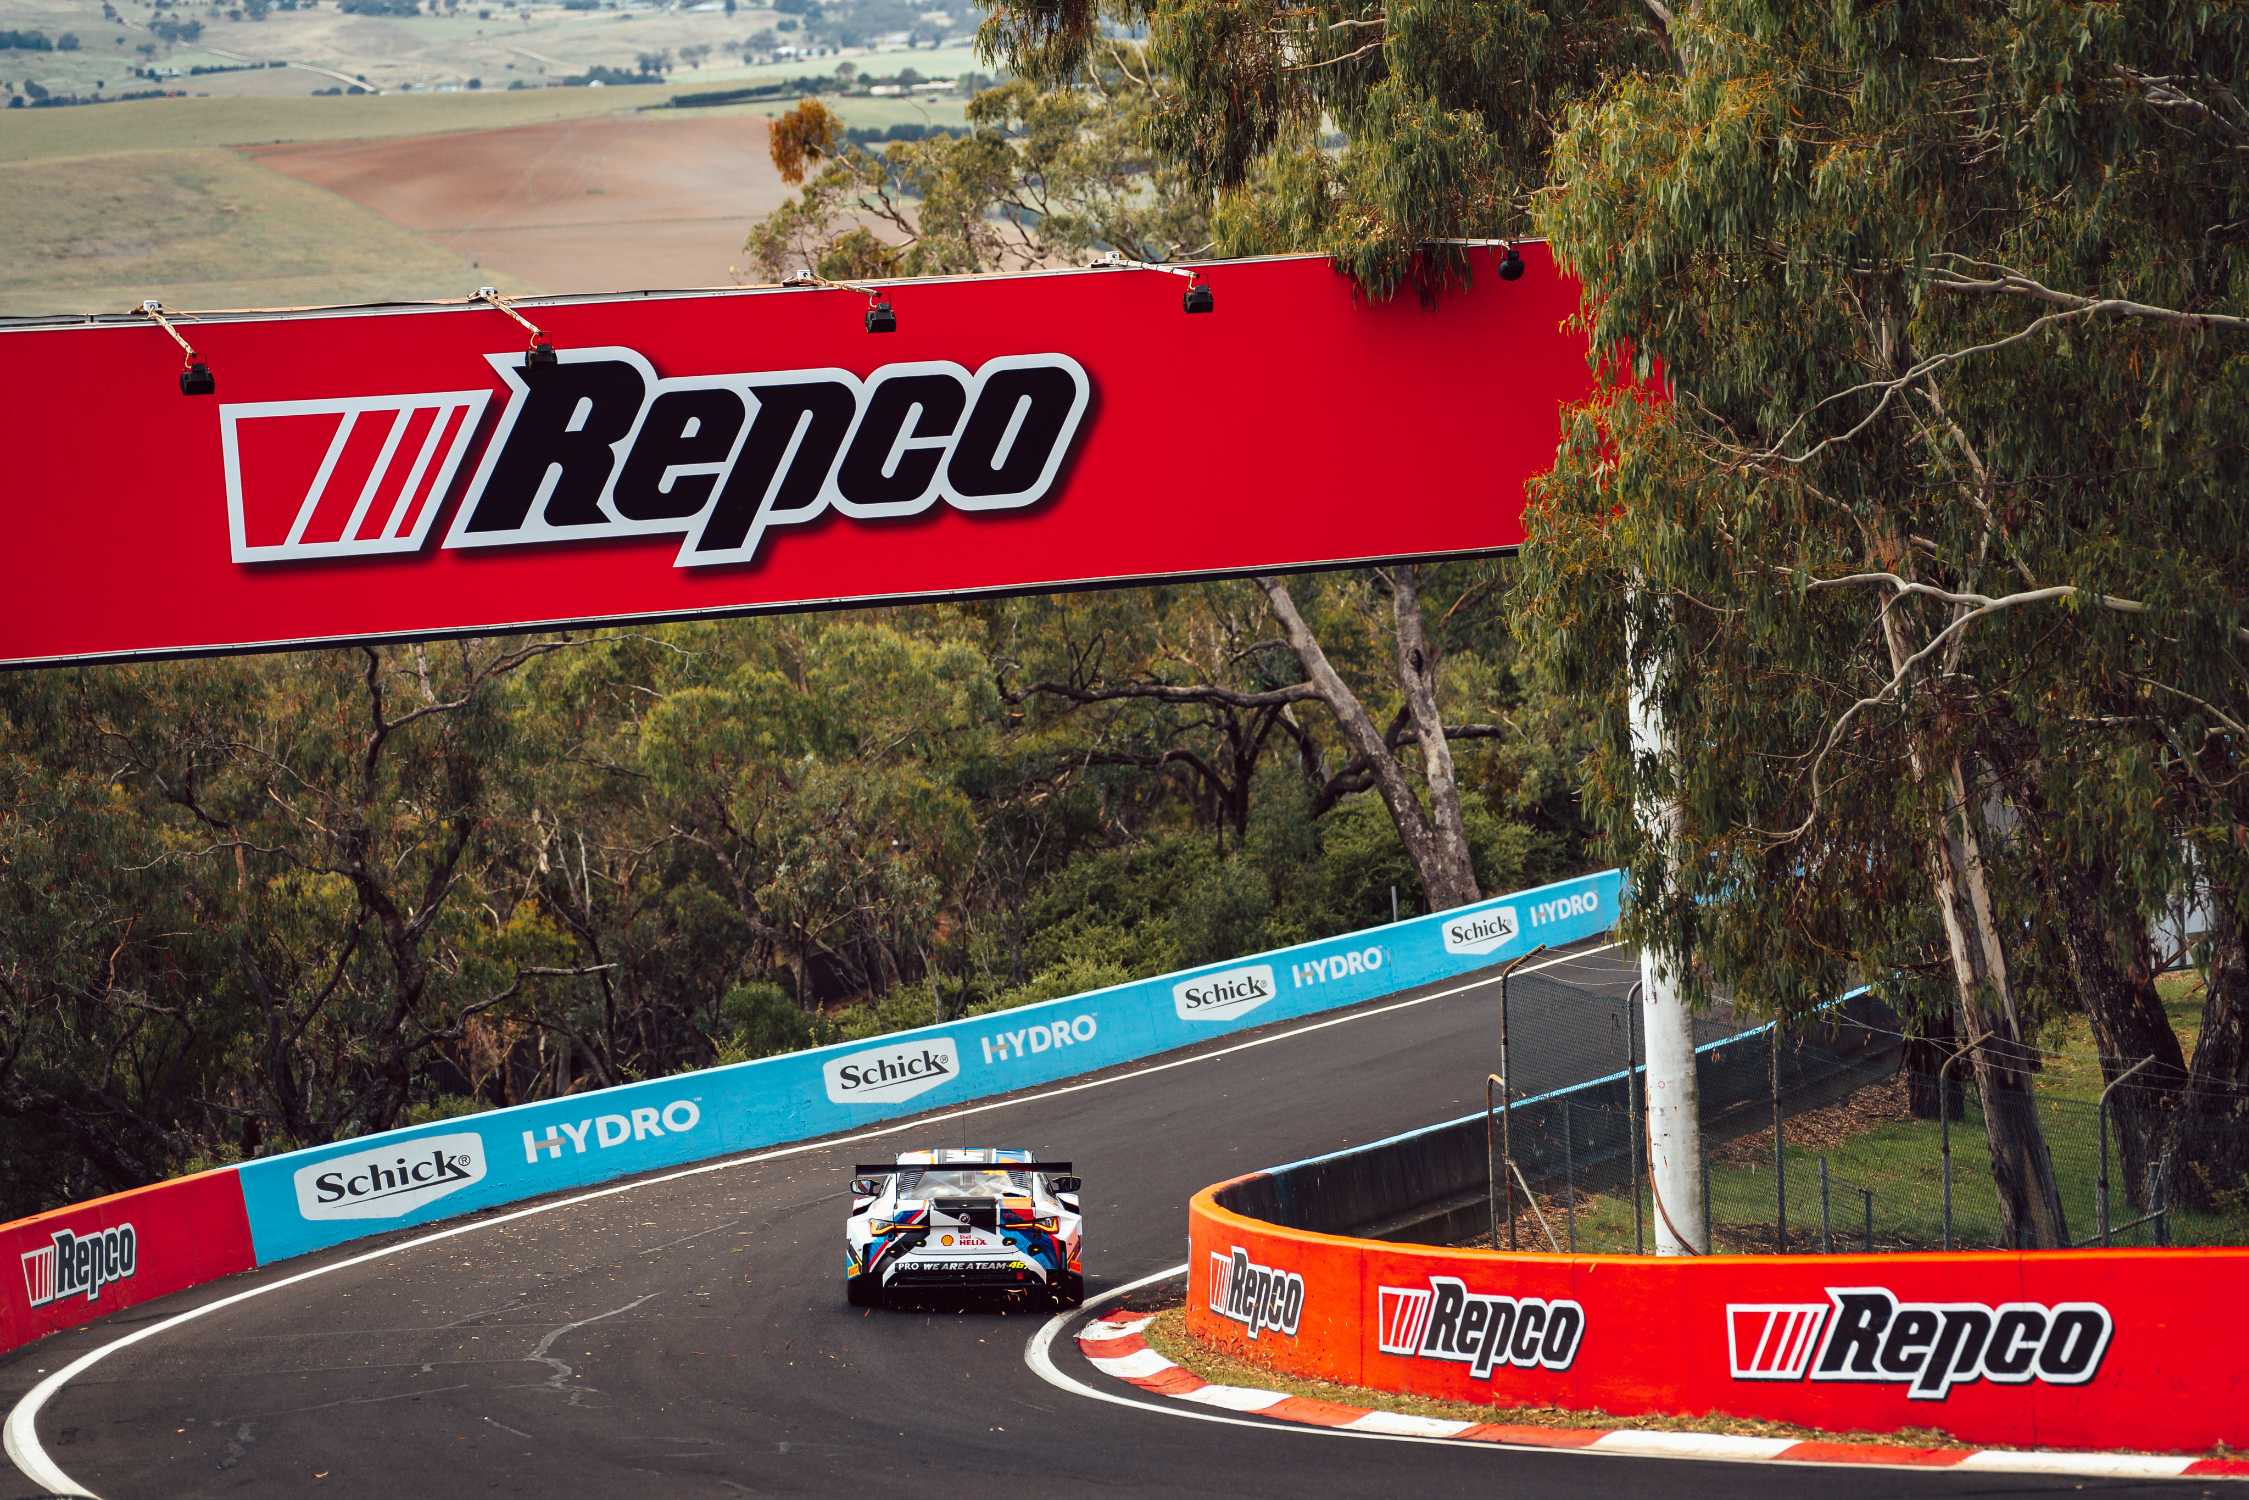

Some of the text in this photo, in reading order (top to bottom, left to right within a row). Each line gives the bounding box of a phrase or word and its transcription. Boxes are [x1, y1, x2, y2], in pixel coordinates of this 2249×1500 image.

[443, 346, 1089, 566] Repco
[1530, 891, 1598, 927] HYDRO
[1292, 946, 1382, 988] HYDRO
[981, 1015, 1097, 1064] HYDRO
[522, 1099, 700, 1163] HYDRO
[51, 1222, 136, 1300] Repco
[898, 1263, 919, 1271] PRO
[923, 1262, 939, 1271] WE
[941, 1262, 965, 1271] ARE
[975, 1262, 1007, 1271] TEAM
[1226, 1246, 1304, 1339] Repco
[1418, 1275, 1585, 1379] Repco
[1810, 1286, 2112, 1400] Repco
